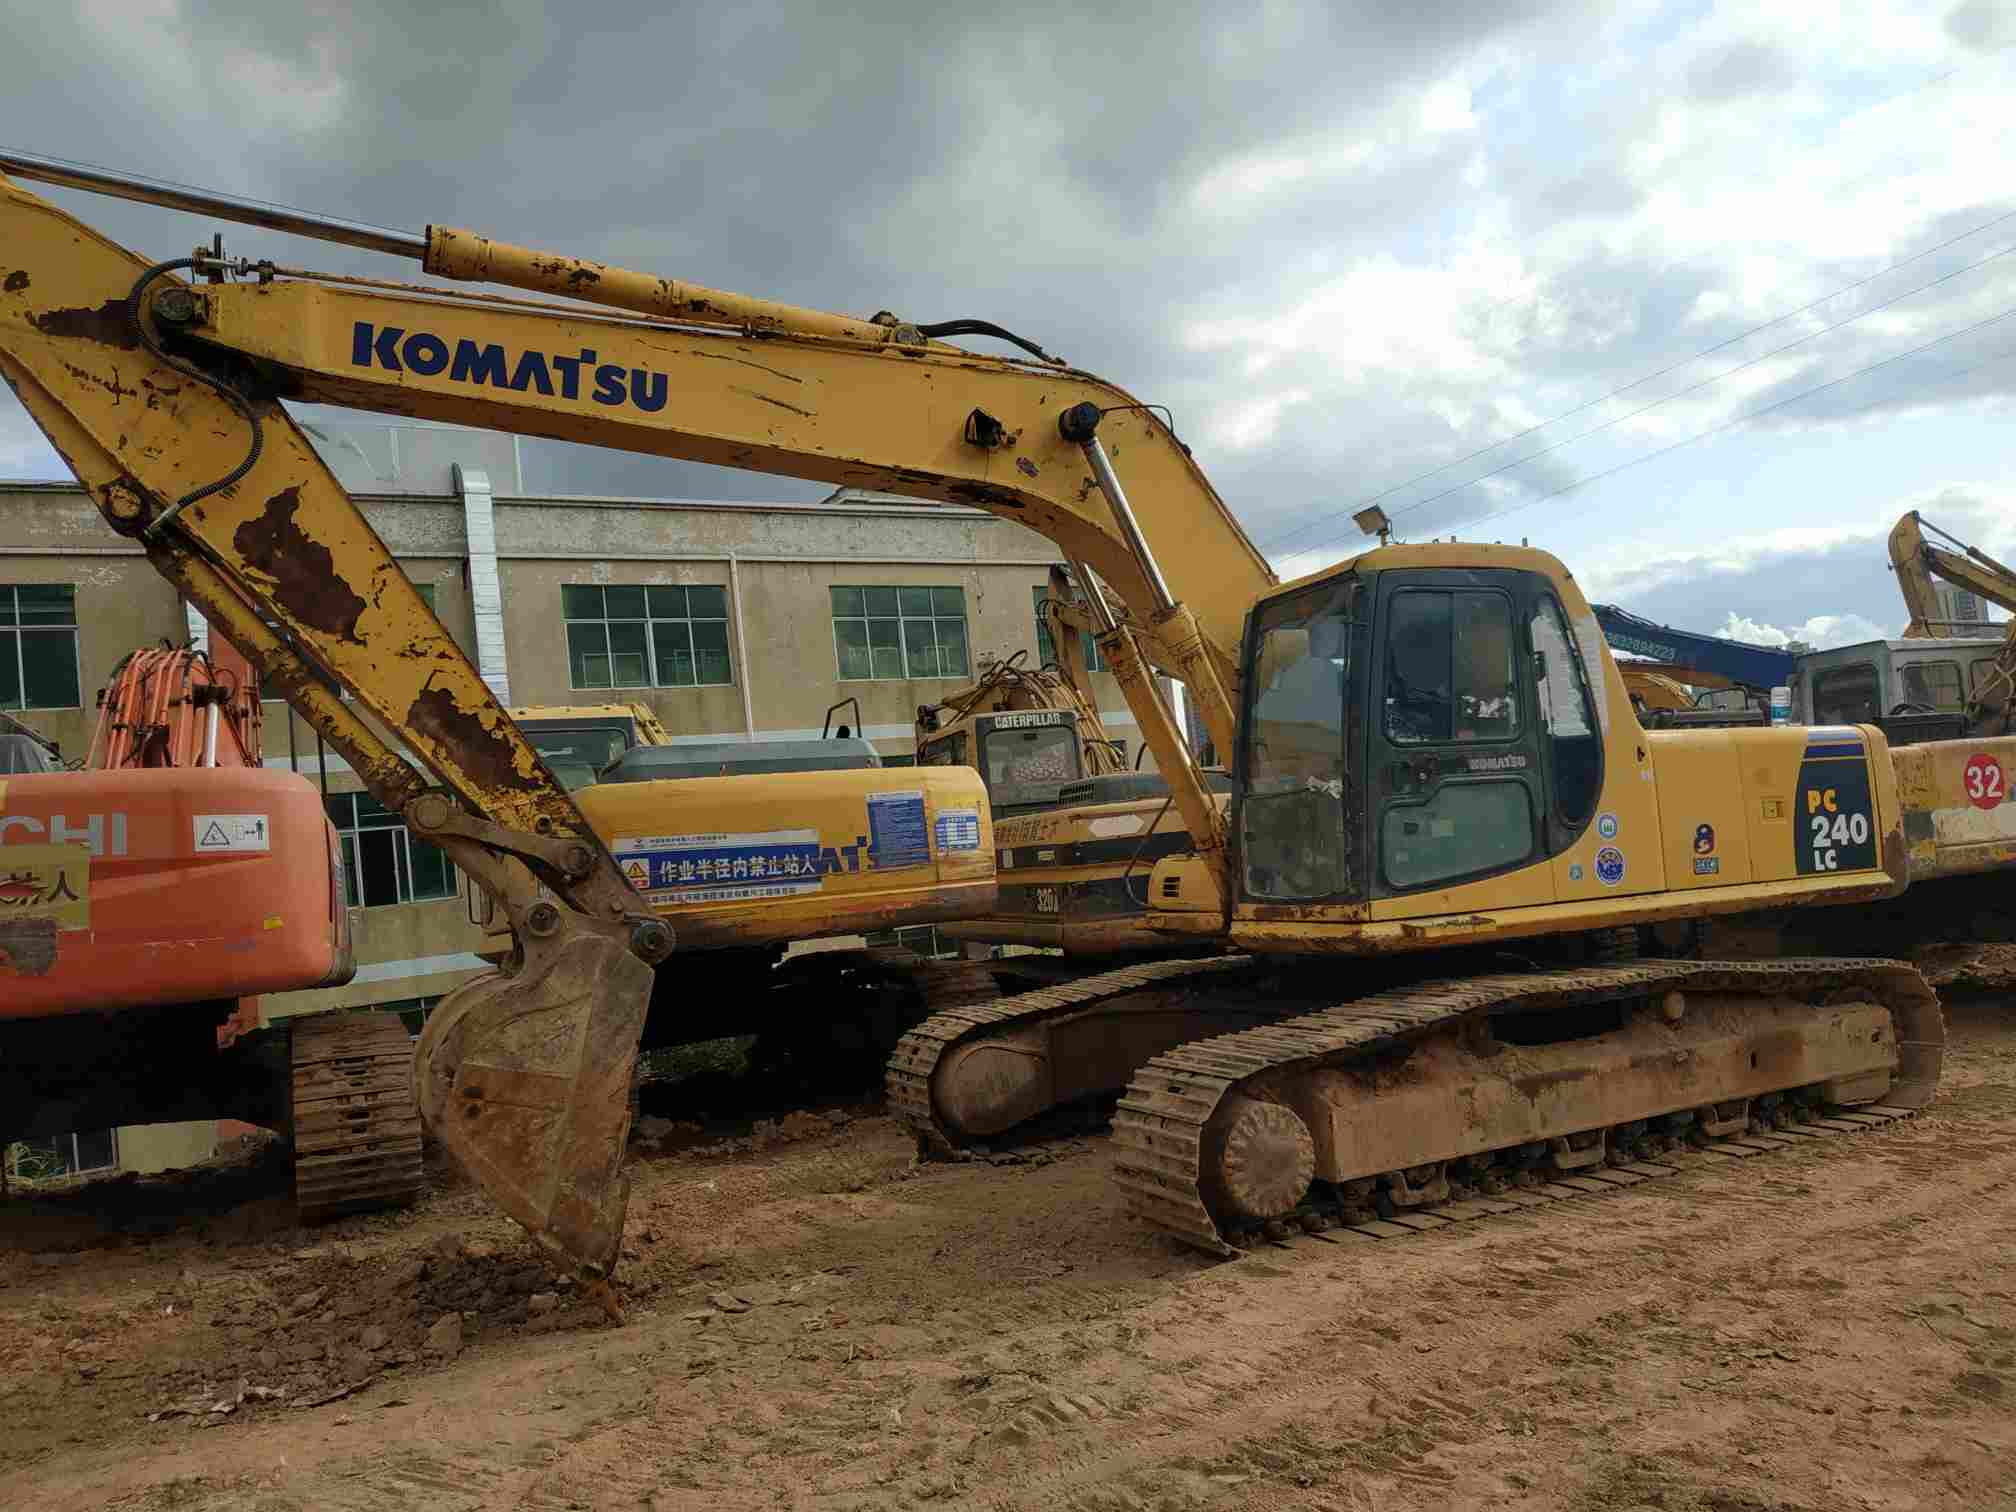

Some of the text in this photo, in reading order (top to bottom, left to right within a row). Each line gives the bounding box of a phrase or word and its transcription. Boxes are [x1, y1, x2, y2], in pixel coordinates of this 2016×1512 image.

[352, 321, 669, 413] KOMATSU
[994, 712, 1061, 729] CATERPILLAR
[1469, 753, 1527, 770] KOMATSU
[1967, 764, 2003, 799] 32
[1807, 789, 1838, 814] PC
[1810, 812, 1868, 848] 240
[660, 853, 816, 883] 作业半径内禁止站人
[1813, 848, 1838, 871] LC
